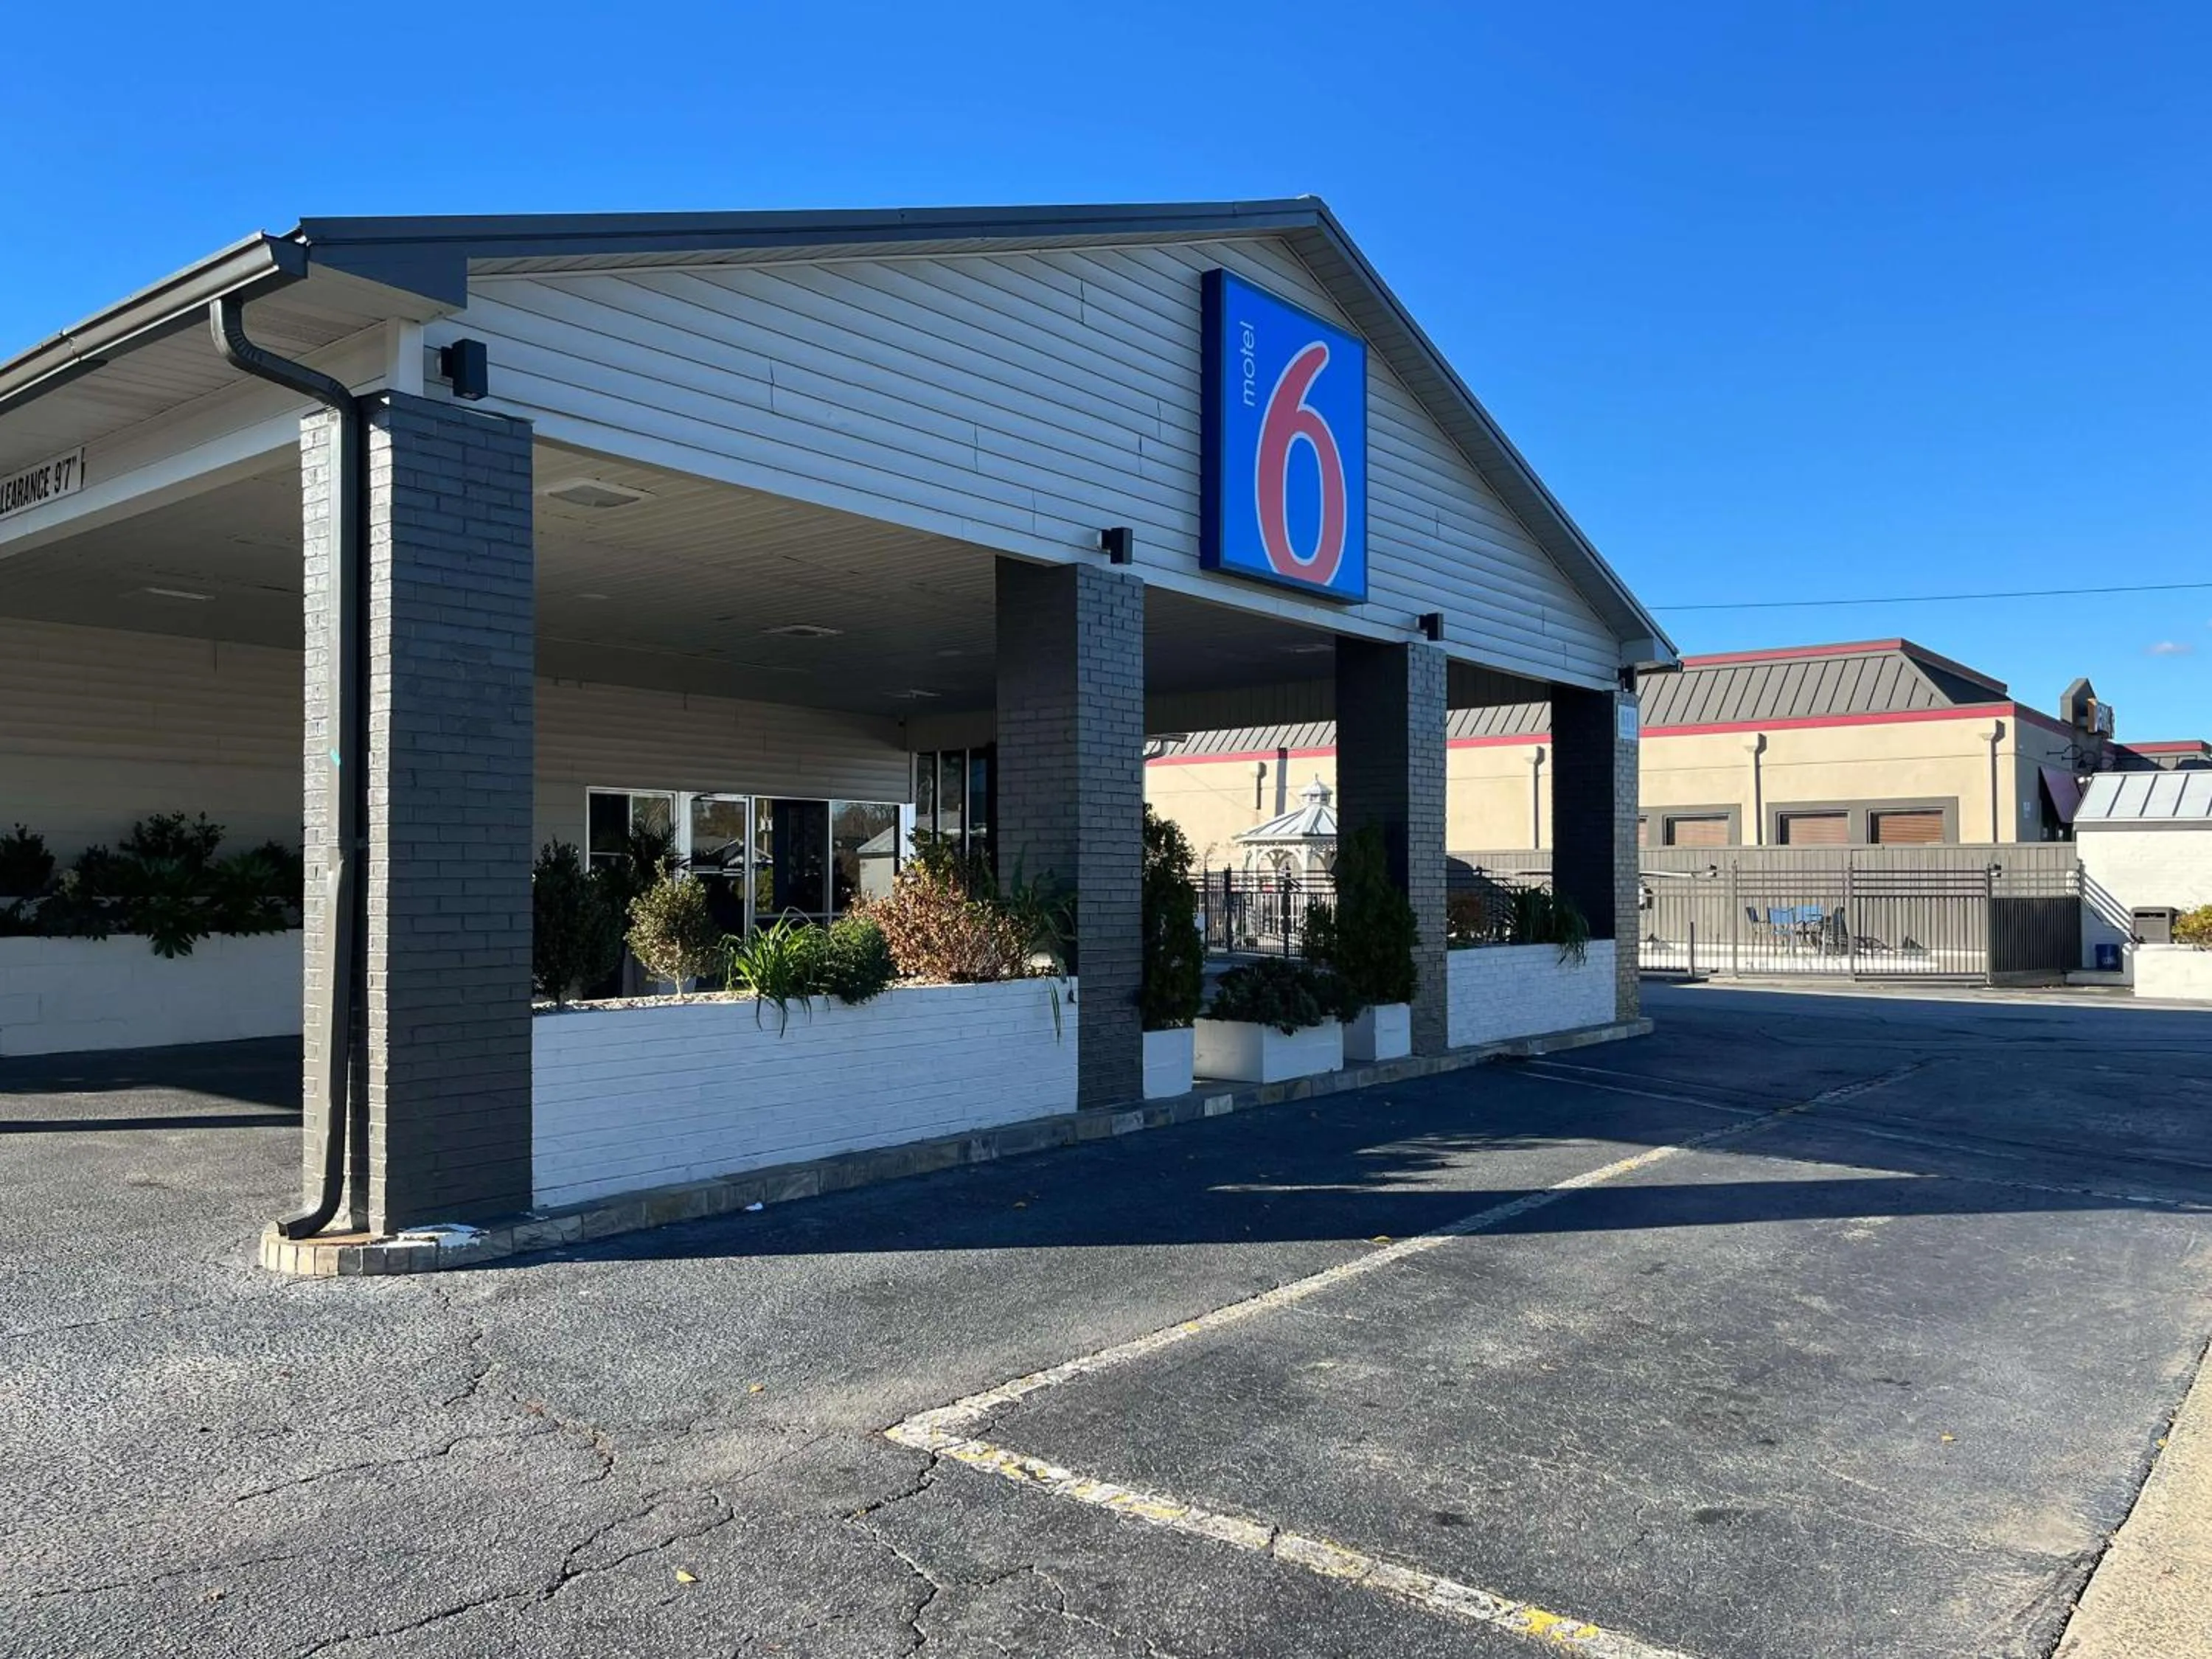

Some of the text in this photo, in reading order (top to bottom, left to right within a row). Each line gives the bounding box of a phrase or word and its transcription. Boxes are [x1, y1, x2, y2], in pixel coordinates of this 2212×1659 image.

[1239, 321, 1255, 406] motel
[0, 466, 50, 515] LEARANCE
[1255, 340, 1347, 585] 6
